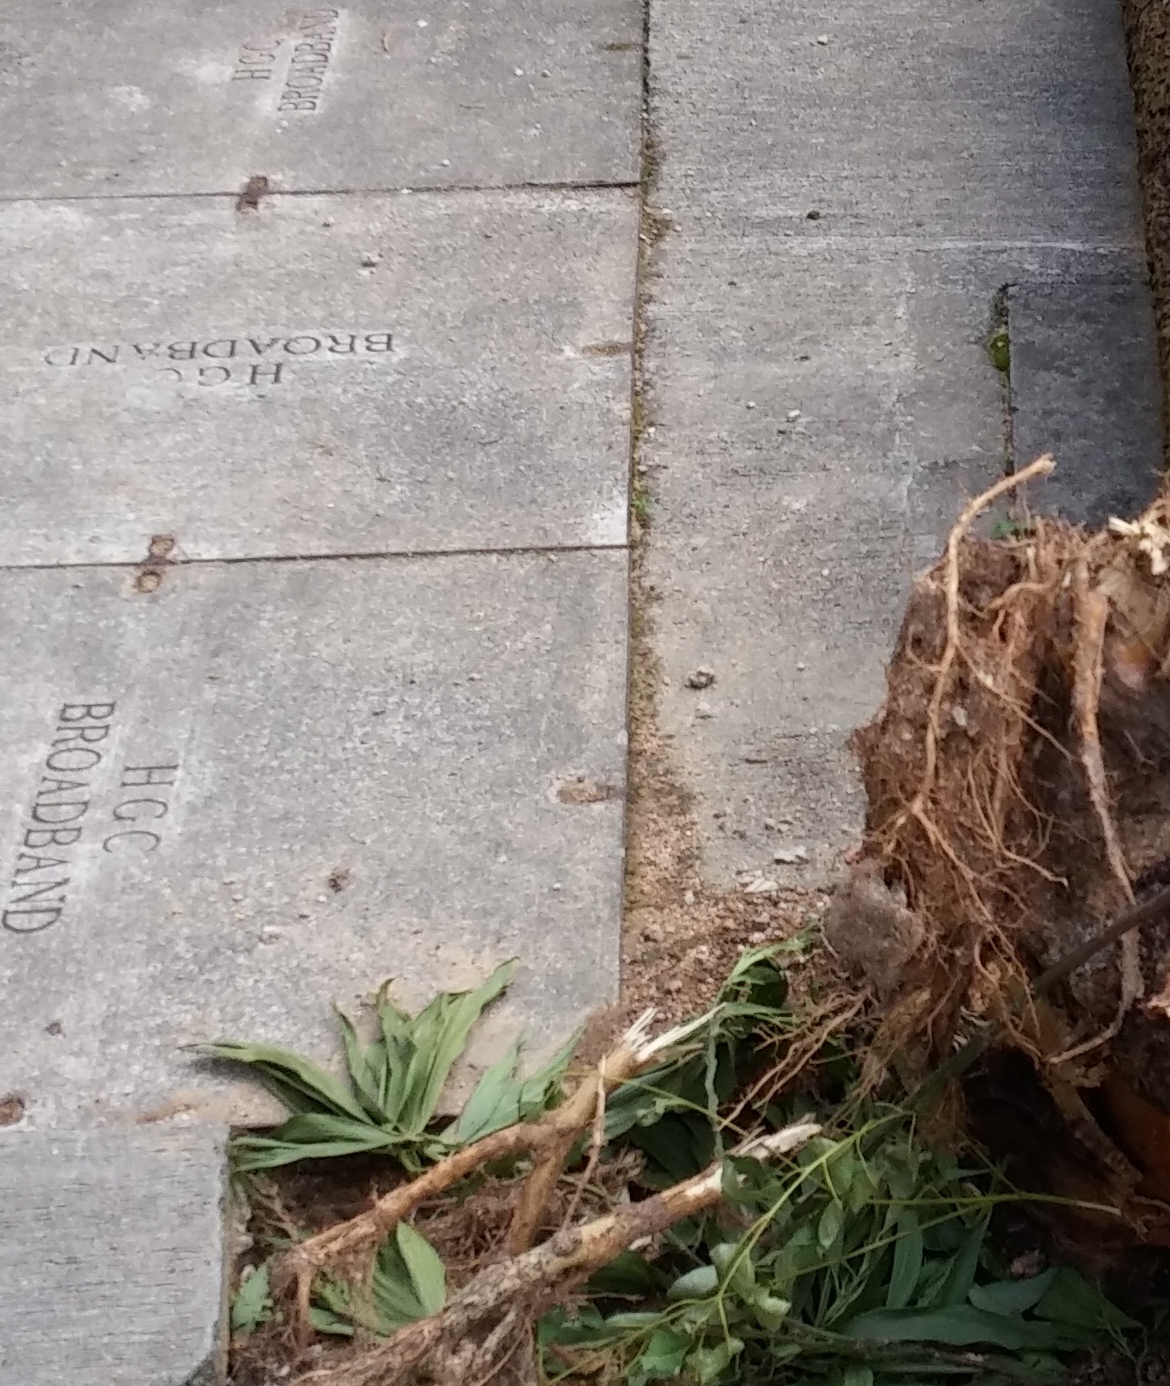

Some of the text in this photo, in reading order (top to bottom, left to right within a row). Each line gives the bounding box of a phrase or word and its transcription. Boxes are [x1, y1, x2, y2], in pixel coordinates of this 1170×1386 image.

[231, 39, 281, 81] HGC
[277, 9, 339, 111] BROADBAND
[44, 332, 396, 366] BROADBAND
[1, 701, 116, 934] BROADBAND
[102, 764, 179, 853] HGC
